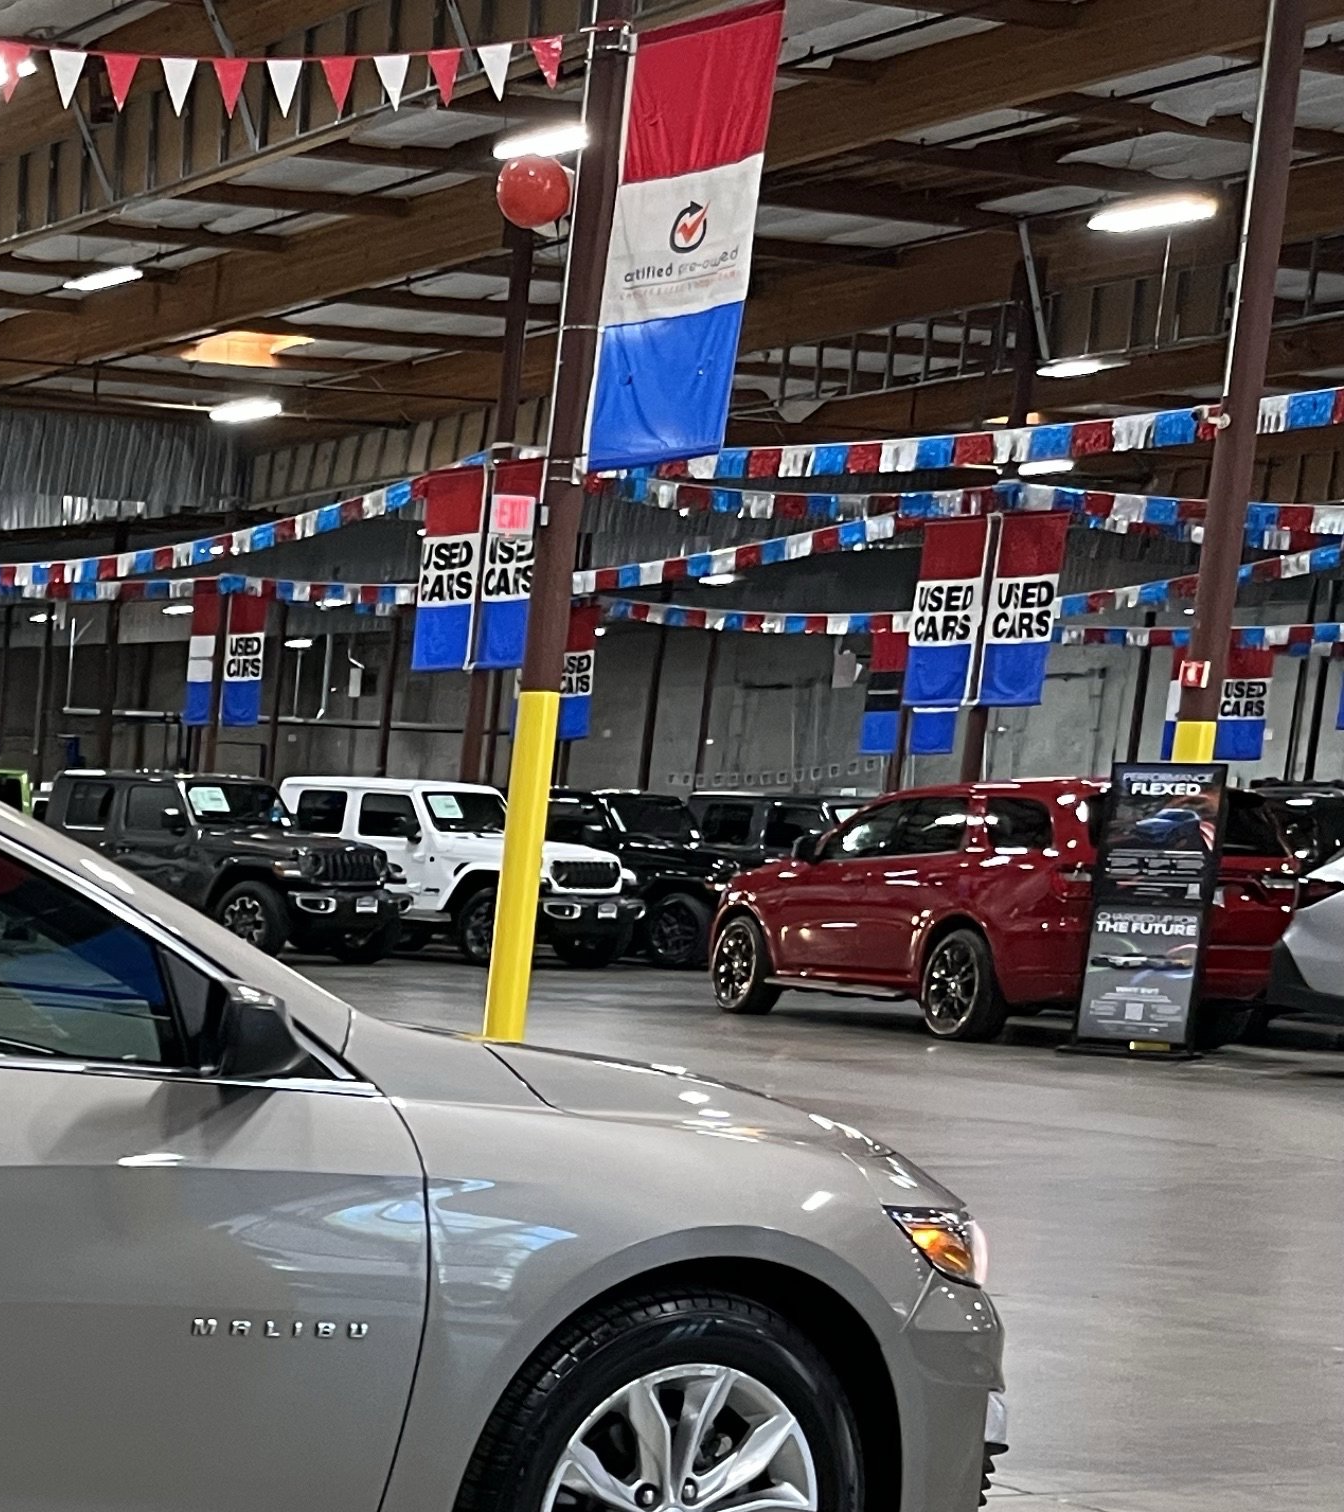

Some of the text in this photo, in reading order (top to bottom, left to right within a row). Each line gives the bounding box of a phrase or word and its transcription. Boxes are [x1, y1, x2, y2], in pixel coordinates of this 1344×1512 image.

[623, 245, 740, 283] ctified pre-owed
[421, 540, 473, 571] USED
[919, 584, 974, 612] USED
[997, 580, 1055, 610] USED
[914, 614, 971, 642] CARS
[992, 610, 1051, 639] CARS
[562, 654, 591, 674] SED
[1224, 681, 1267, 699] USED
[1220, 700, 1265, 717] CARS
[1131, 782, 1201, 796] FLEXED
[1096, 920, 1197, 936] THE FUTURE
[191, 1317, 370, 1339] MALIBU
